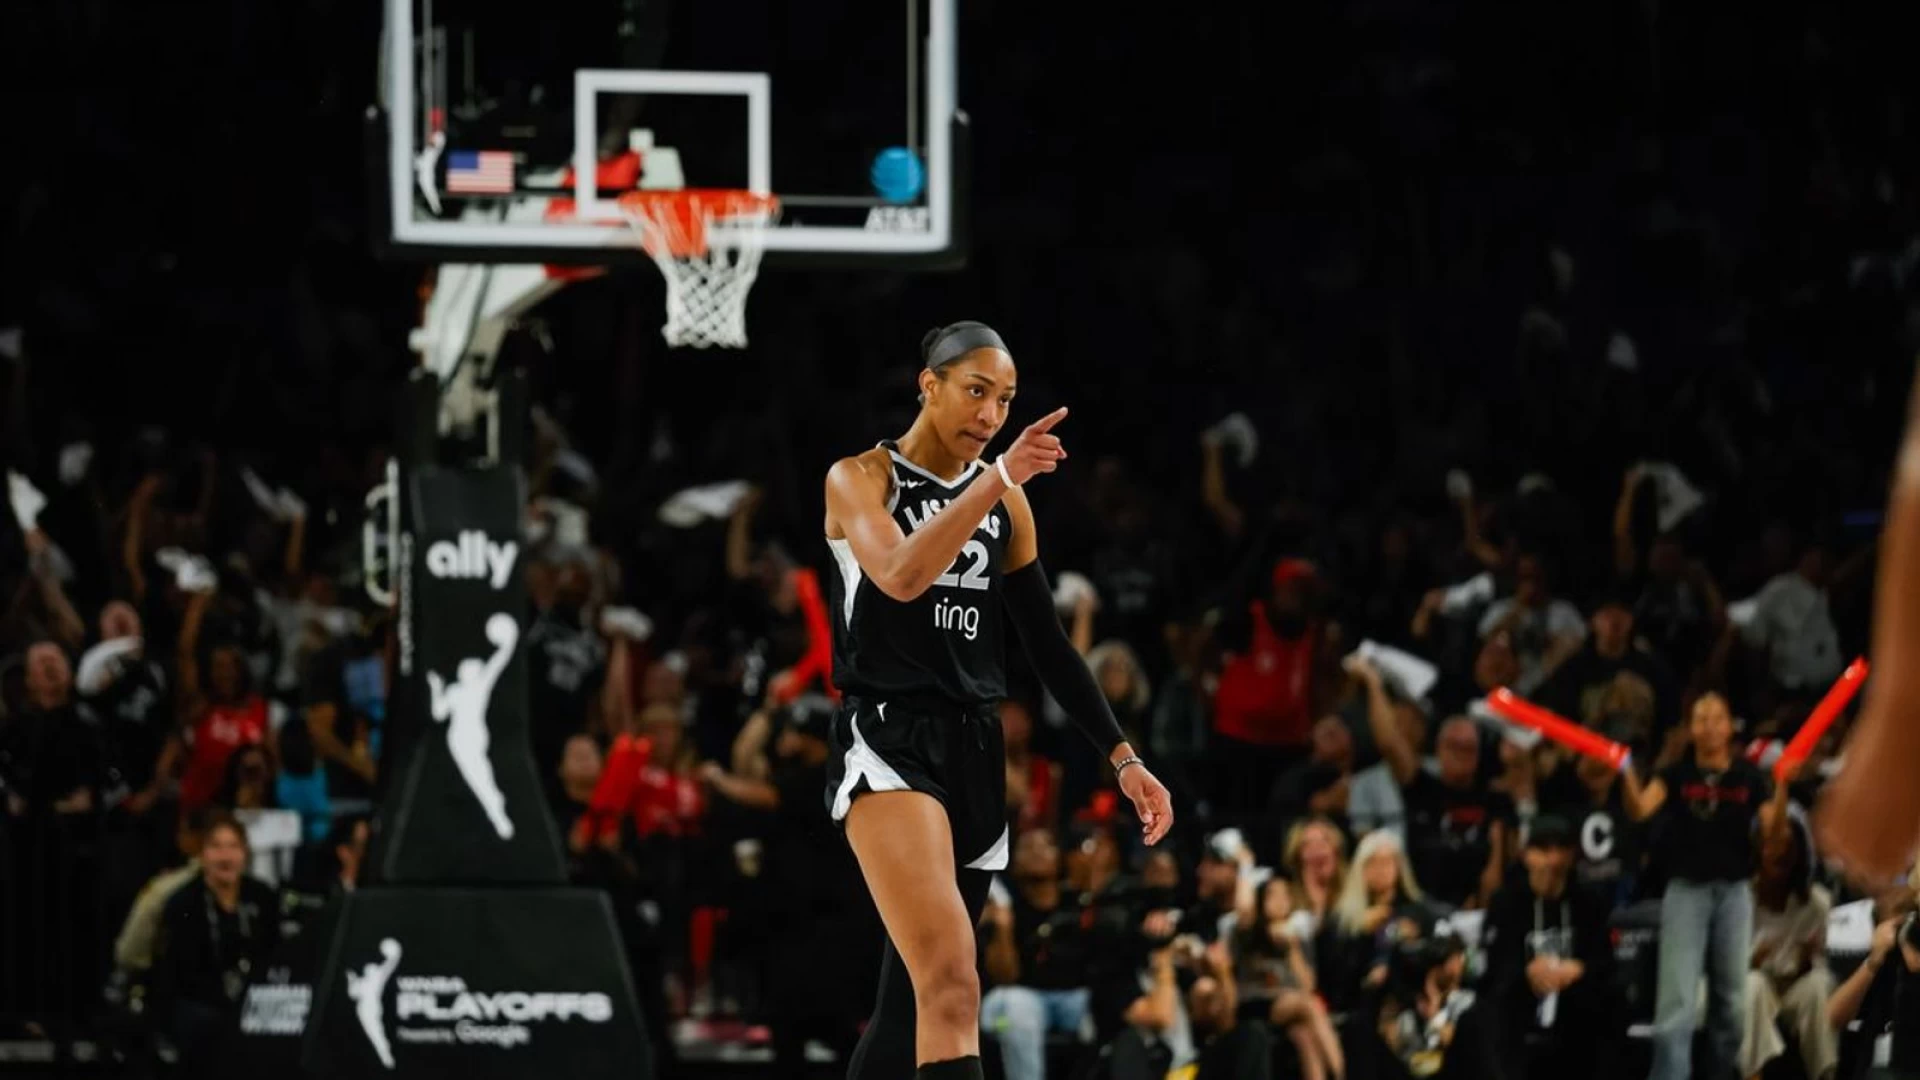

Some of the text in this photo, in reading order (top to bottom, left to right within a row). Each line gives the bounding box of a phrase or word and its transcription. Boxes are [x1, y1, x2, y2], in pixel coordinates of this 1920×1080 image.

[864, 206, 930, 231] AT&T
[426, 529, 518, 590] ally
[935, 597, 979, 640] ring
[1580, 811, 1615, 862] C
[397, 991, 613, 1022] PLAYOFFS
